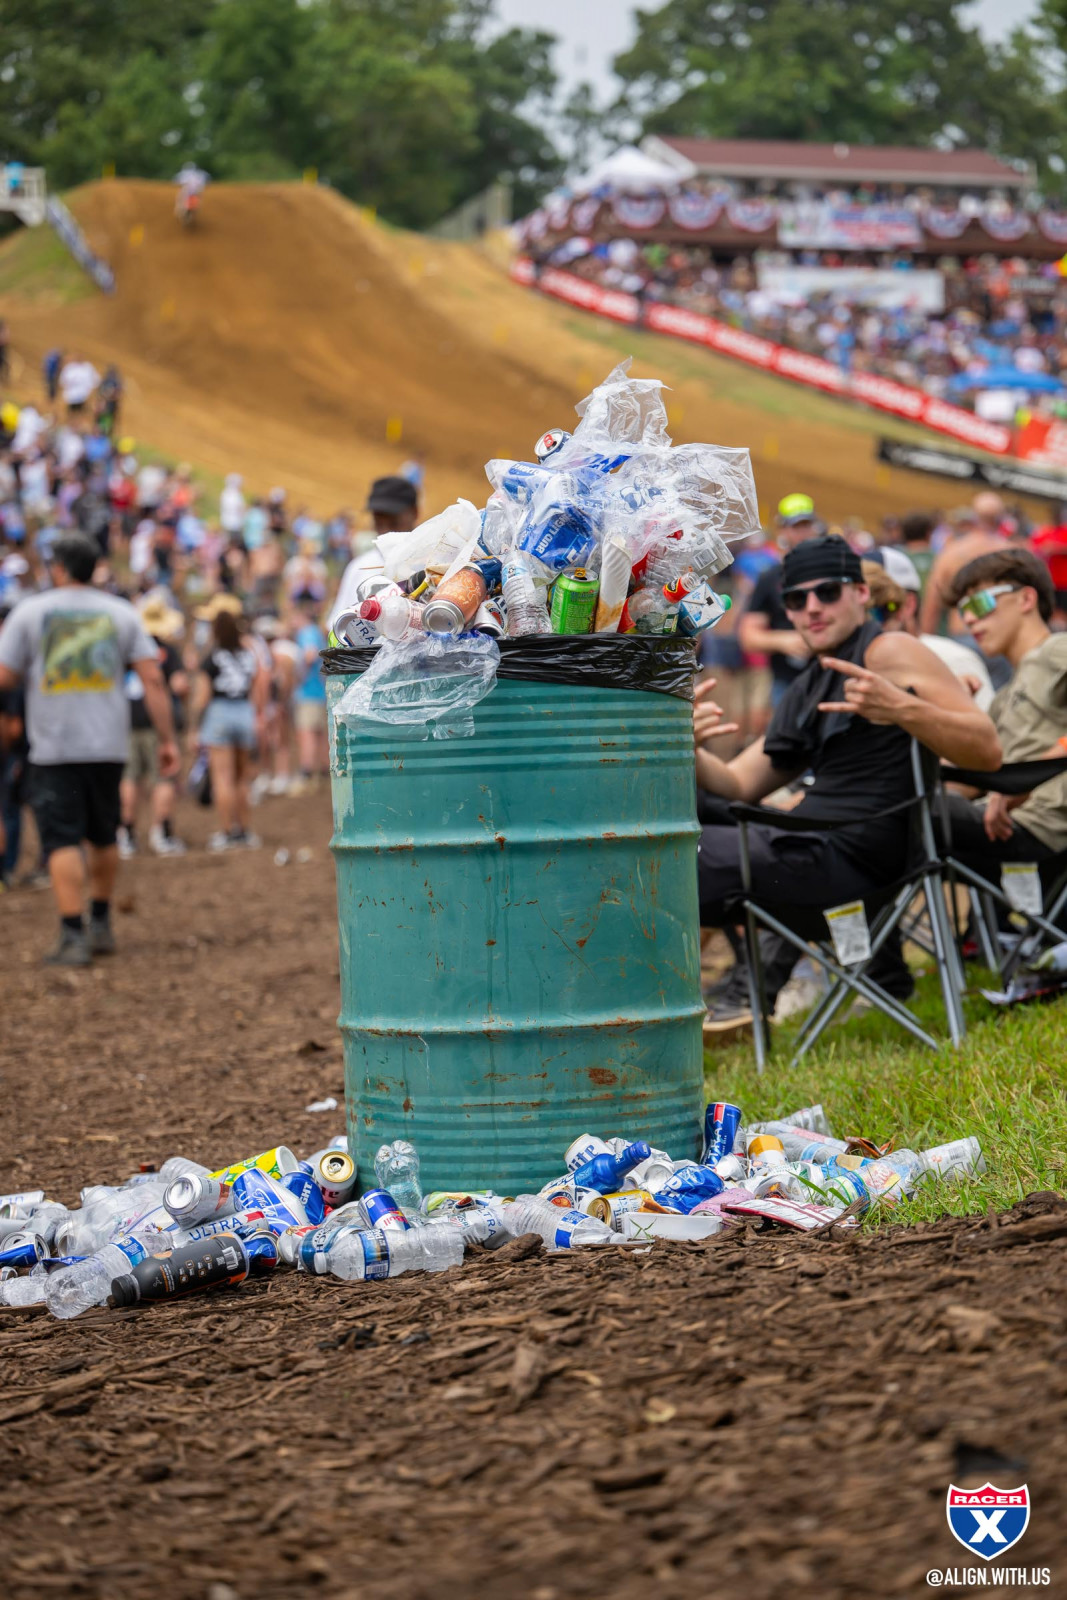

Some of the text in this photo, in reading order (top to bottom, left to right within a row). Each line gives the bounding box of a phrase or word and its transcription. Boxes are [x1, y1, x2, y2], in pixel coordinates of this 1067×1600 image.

[535, 535, 553, 554] BUD
[551, 513, 571, 536] LIGH
[353, 619, 375, 645] TRA
[300, 1181, 313, 1205] GHT
[189, 1217, 243, 1241] ULTRA
[479, 1205, 497, 1238] LTRA
